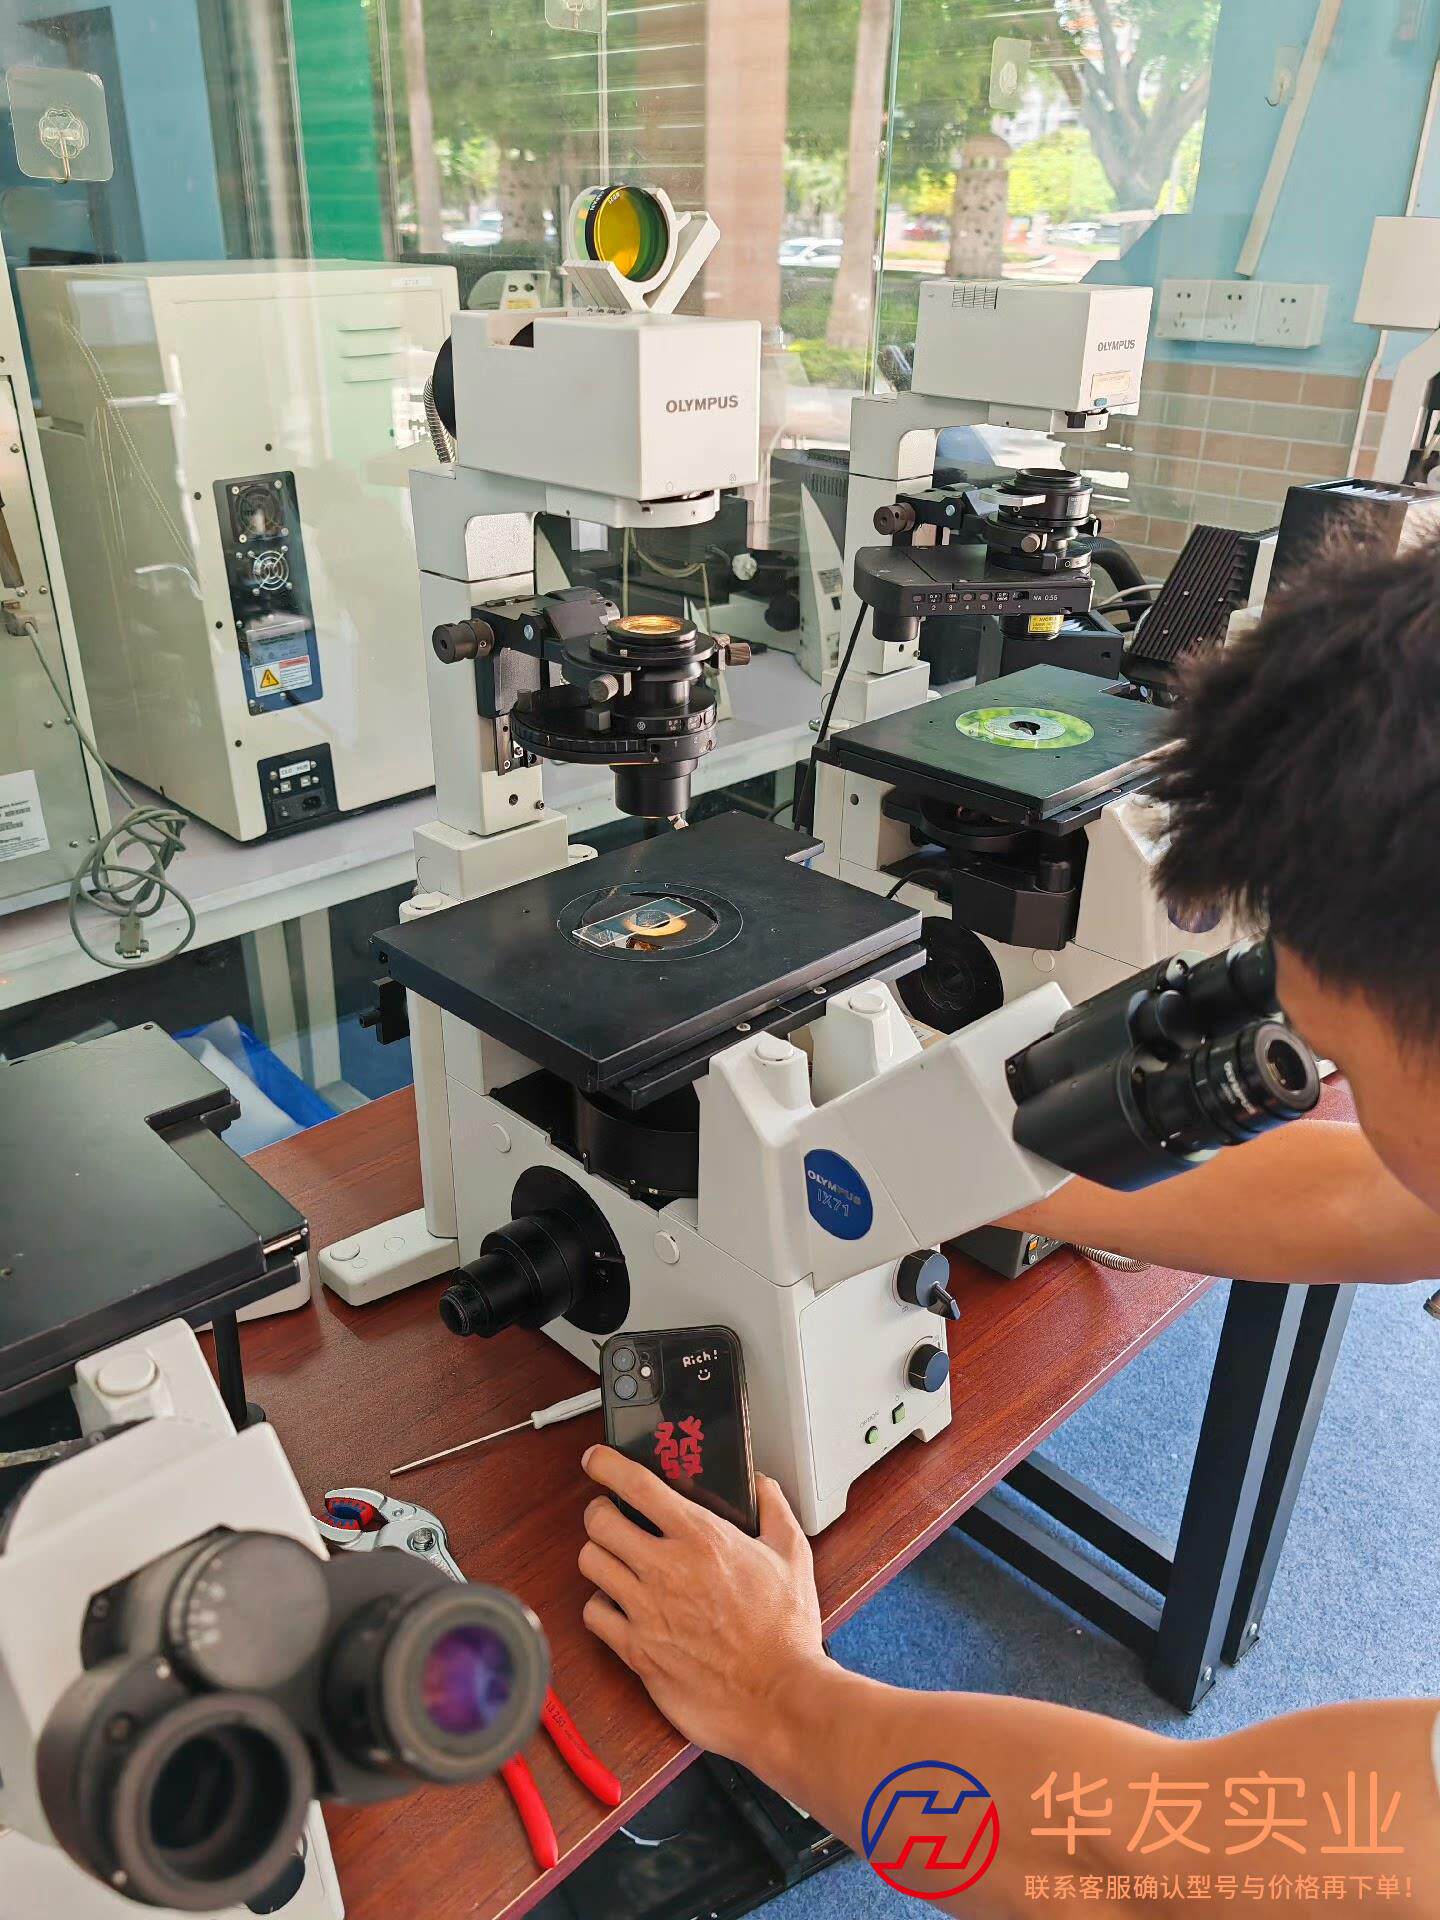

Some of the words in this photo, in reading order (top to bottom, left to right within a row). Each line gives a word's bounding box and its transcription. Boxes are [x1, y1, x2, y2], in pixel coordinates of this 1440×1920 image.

[1097, 339, 1136, 352] OLYMPUS
[665, 395, 739, 413] OLYMPUS
[807, 1169, 861, 1205] OLYMPUS
[817, 1188, 849, 1217] IX71
[682, 1349, 718, 1368] Rich!
